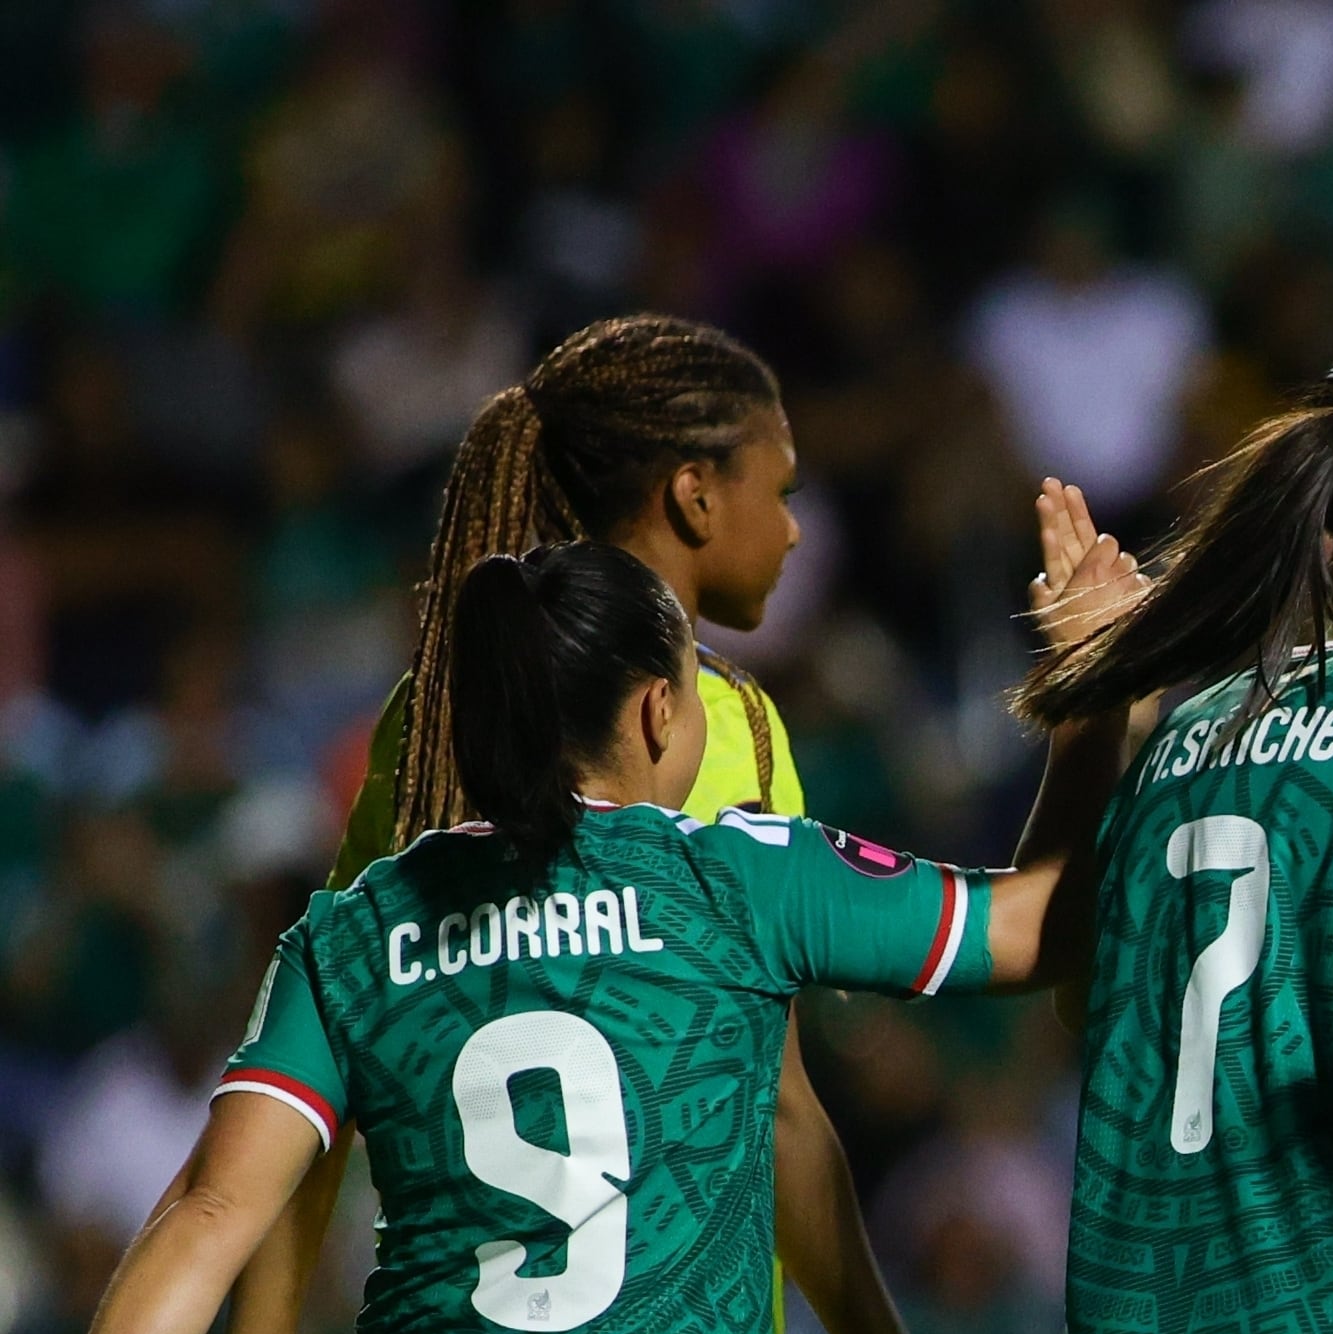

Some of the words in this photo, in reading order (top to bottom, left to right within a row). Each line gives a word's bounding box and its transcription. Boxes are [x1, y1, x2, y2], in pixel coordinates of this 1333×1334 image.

[388, 886, 664, 986] C.CORRAL
[1167, 814, 1270, 1154] 7
[453, 1011, 631, 1333] 9
